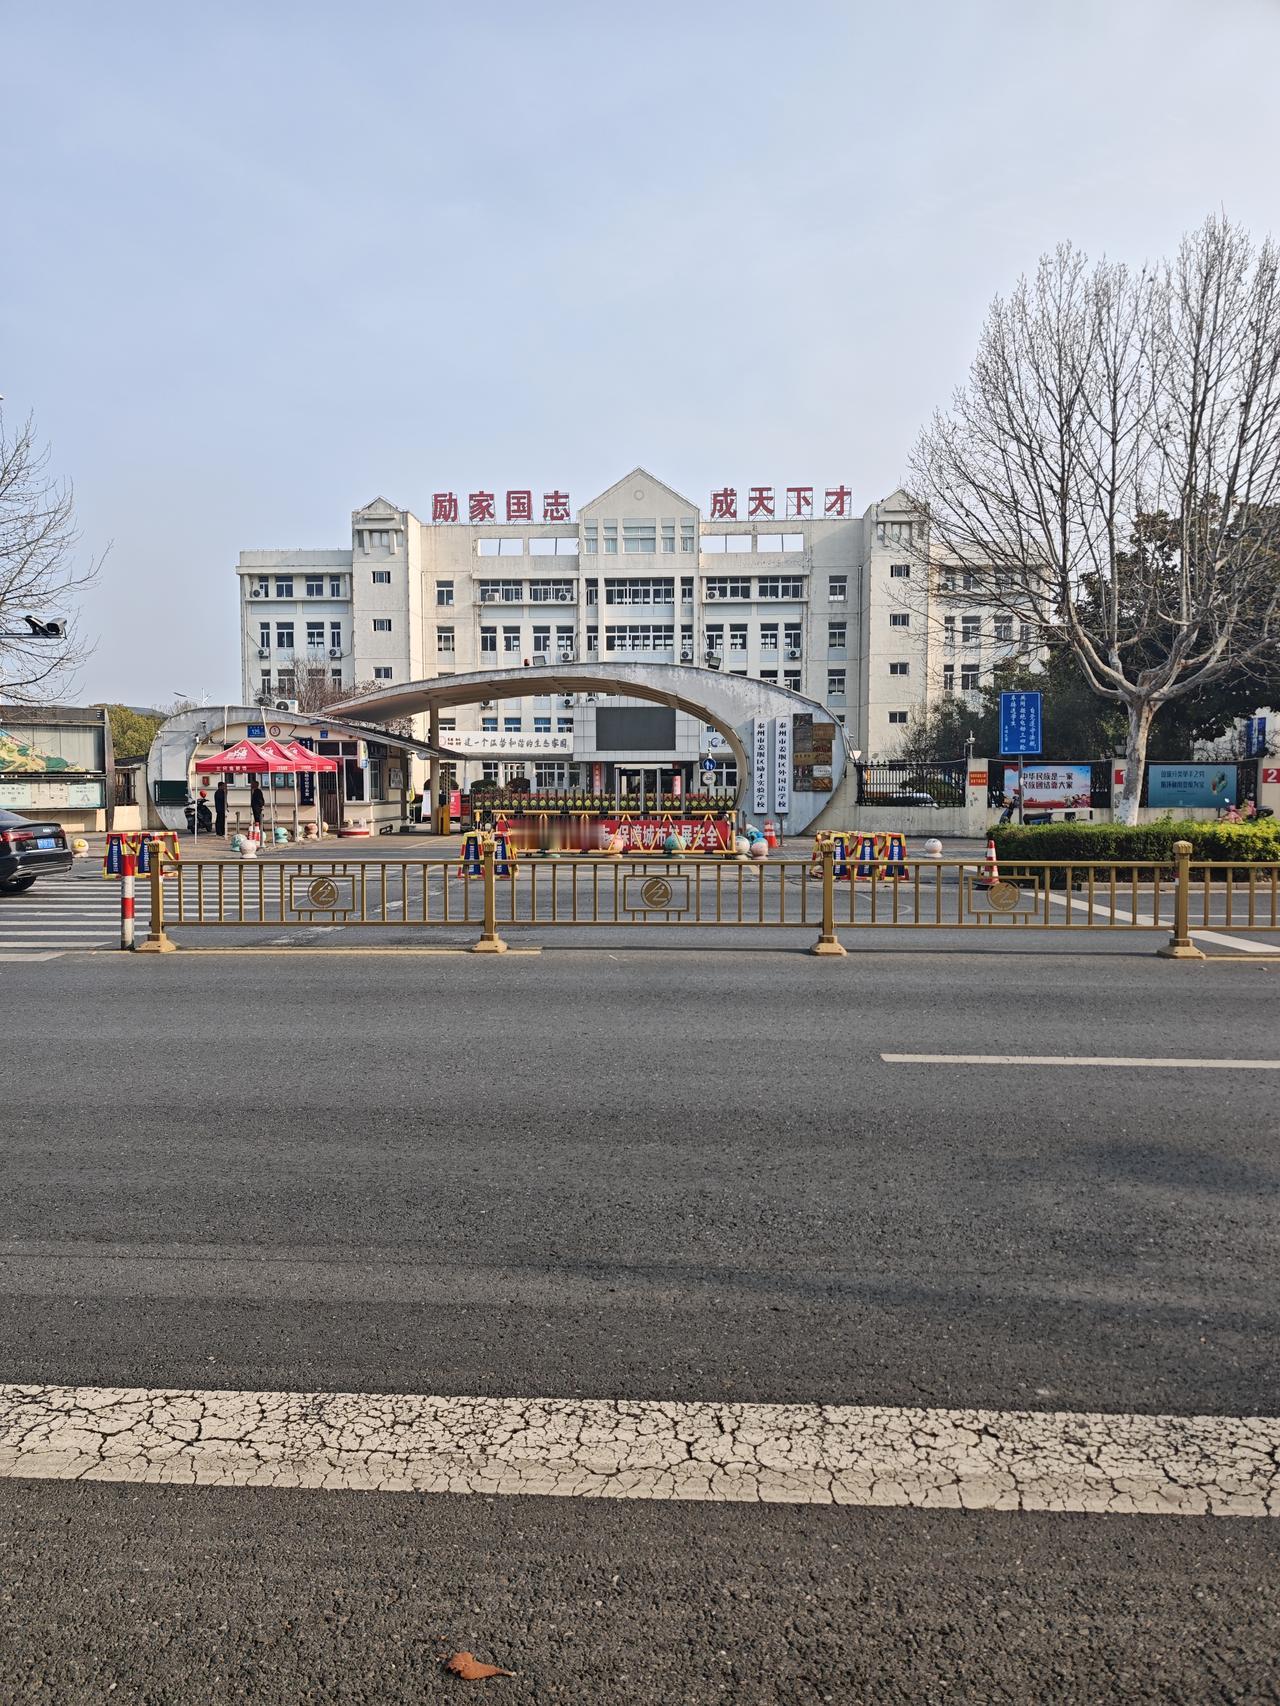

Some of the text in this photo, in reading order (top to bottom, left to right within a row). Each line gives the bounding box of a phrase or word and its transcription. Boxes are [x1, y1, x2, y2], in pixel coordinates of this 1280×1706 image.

[433, 485, 852, 522] 励家国志 成天下才
[756, 722, 766, 809] 泰州市姜堰区励才实验学校
[778, 721, 787, 809] 泰州市姜堰区外国语学校
[1267, 769, 1278, 783] 2
